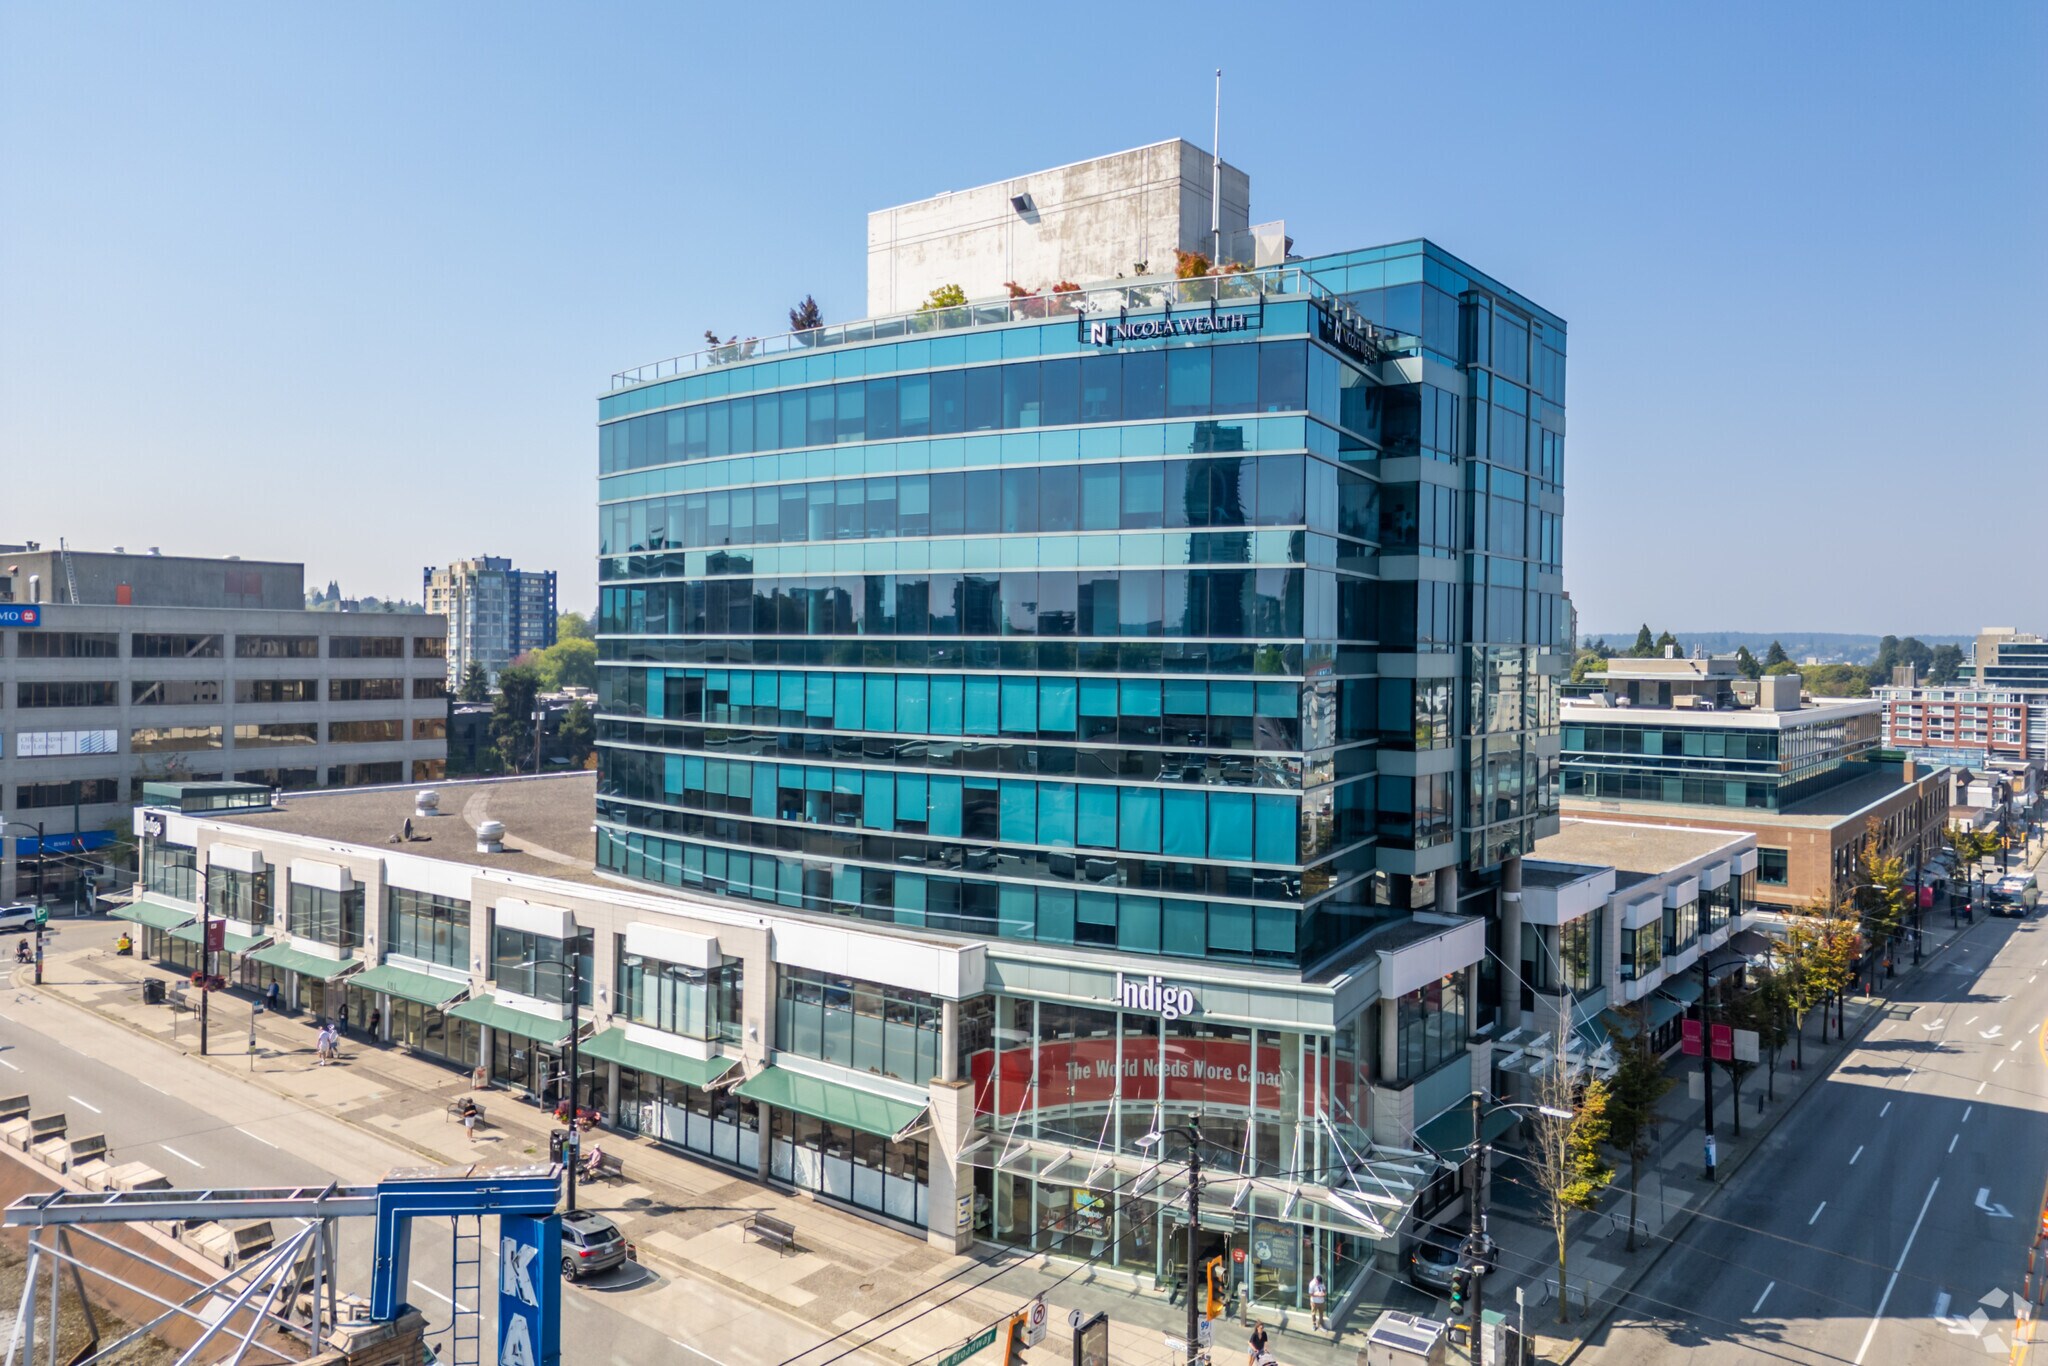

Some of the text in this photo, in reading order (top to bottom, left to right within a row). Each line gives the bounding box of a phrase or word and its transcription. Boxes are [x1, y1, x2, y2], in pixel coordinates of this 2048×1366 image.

[1116, 319, 1175, 339] NICOLA
[1179, 314, 1244, 333] WEALTH
[1065, 1061, 1091, 1080] The
[1193, 1060, 1232, 1080] More
[951, 1332, 993, 1366] Broadway
